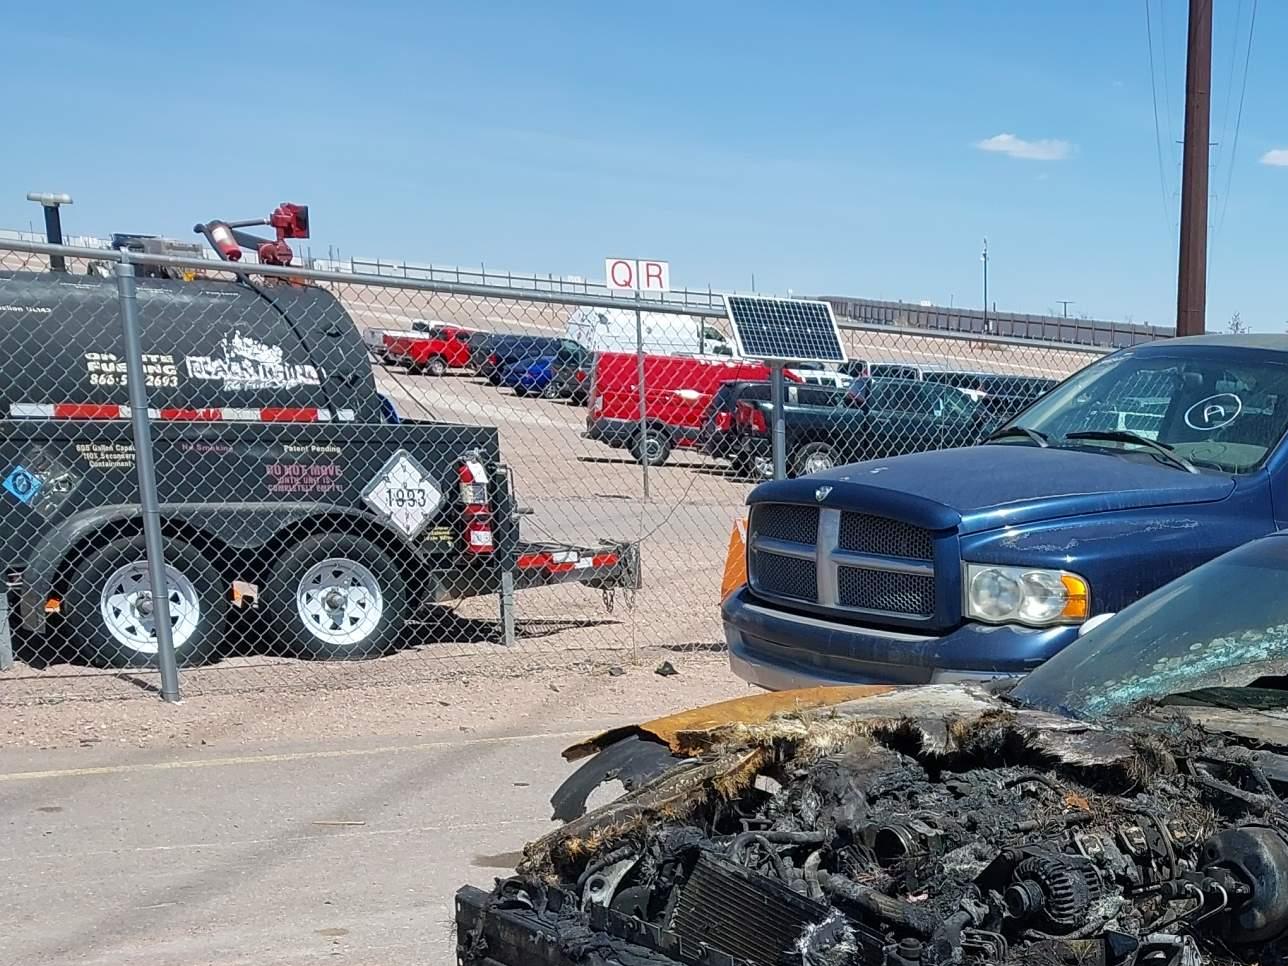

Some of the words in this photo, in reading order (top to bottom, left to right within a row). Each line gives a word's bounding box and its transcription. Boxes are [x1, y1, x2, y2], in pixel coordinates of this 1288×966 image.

[611, 260, 633, 289] Q
[646, 262, 664, 289] R
[141, 353, 174, 363] ITE
[86, 361, 178, 375] FUEING
[1203, 404, 1225, 423] A
[283, 444, 309, 453] Patent
[311, 445, 341, 454] Pending
[386, 488, 427, 508] 1993
